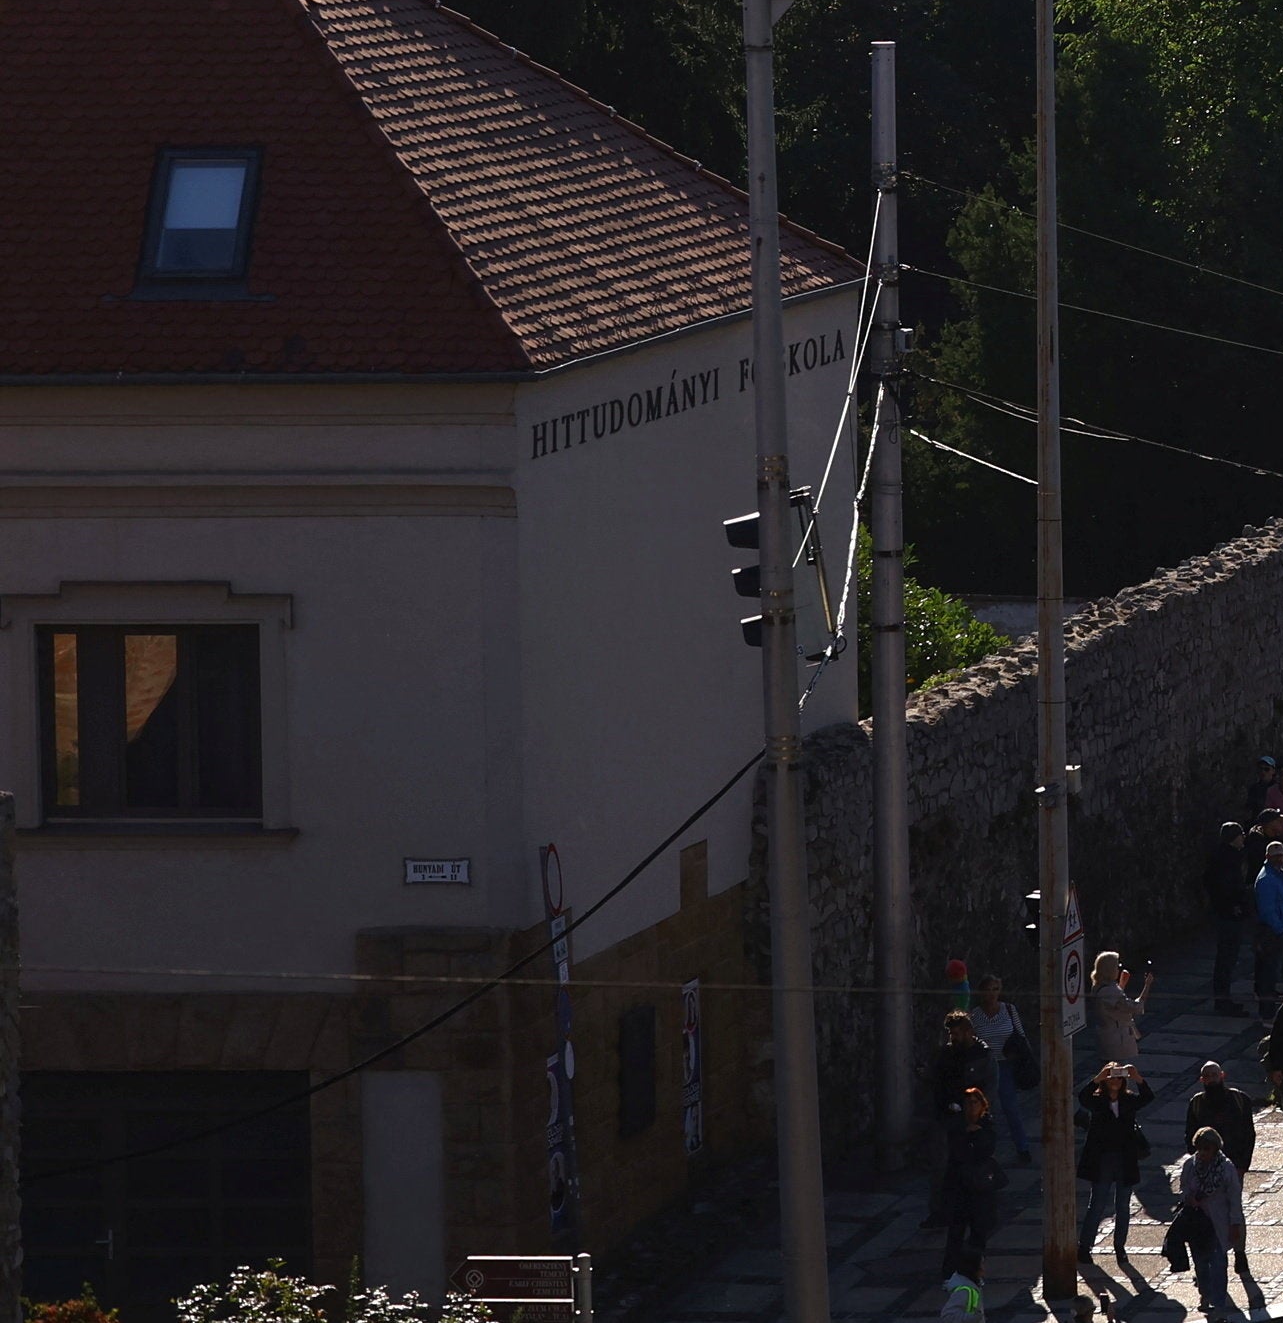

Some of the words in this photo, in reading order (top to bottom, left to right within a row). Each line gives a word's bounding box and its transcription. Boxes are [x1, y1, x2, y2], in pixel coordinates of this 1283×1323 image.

[531, 368, 719, 459] HITTUDOMÁNYI
[413, 864, 444, 874] HUNYADI
[451, 861, 461, 874] ÚT
